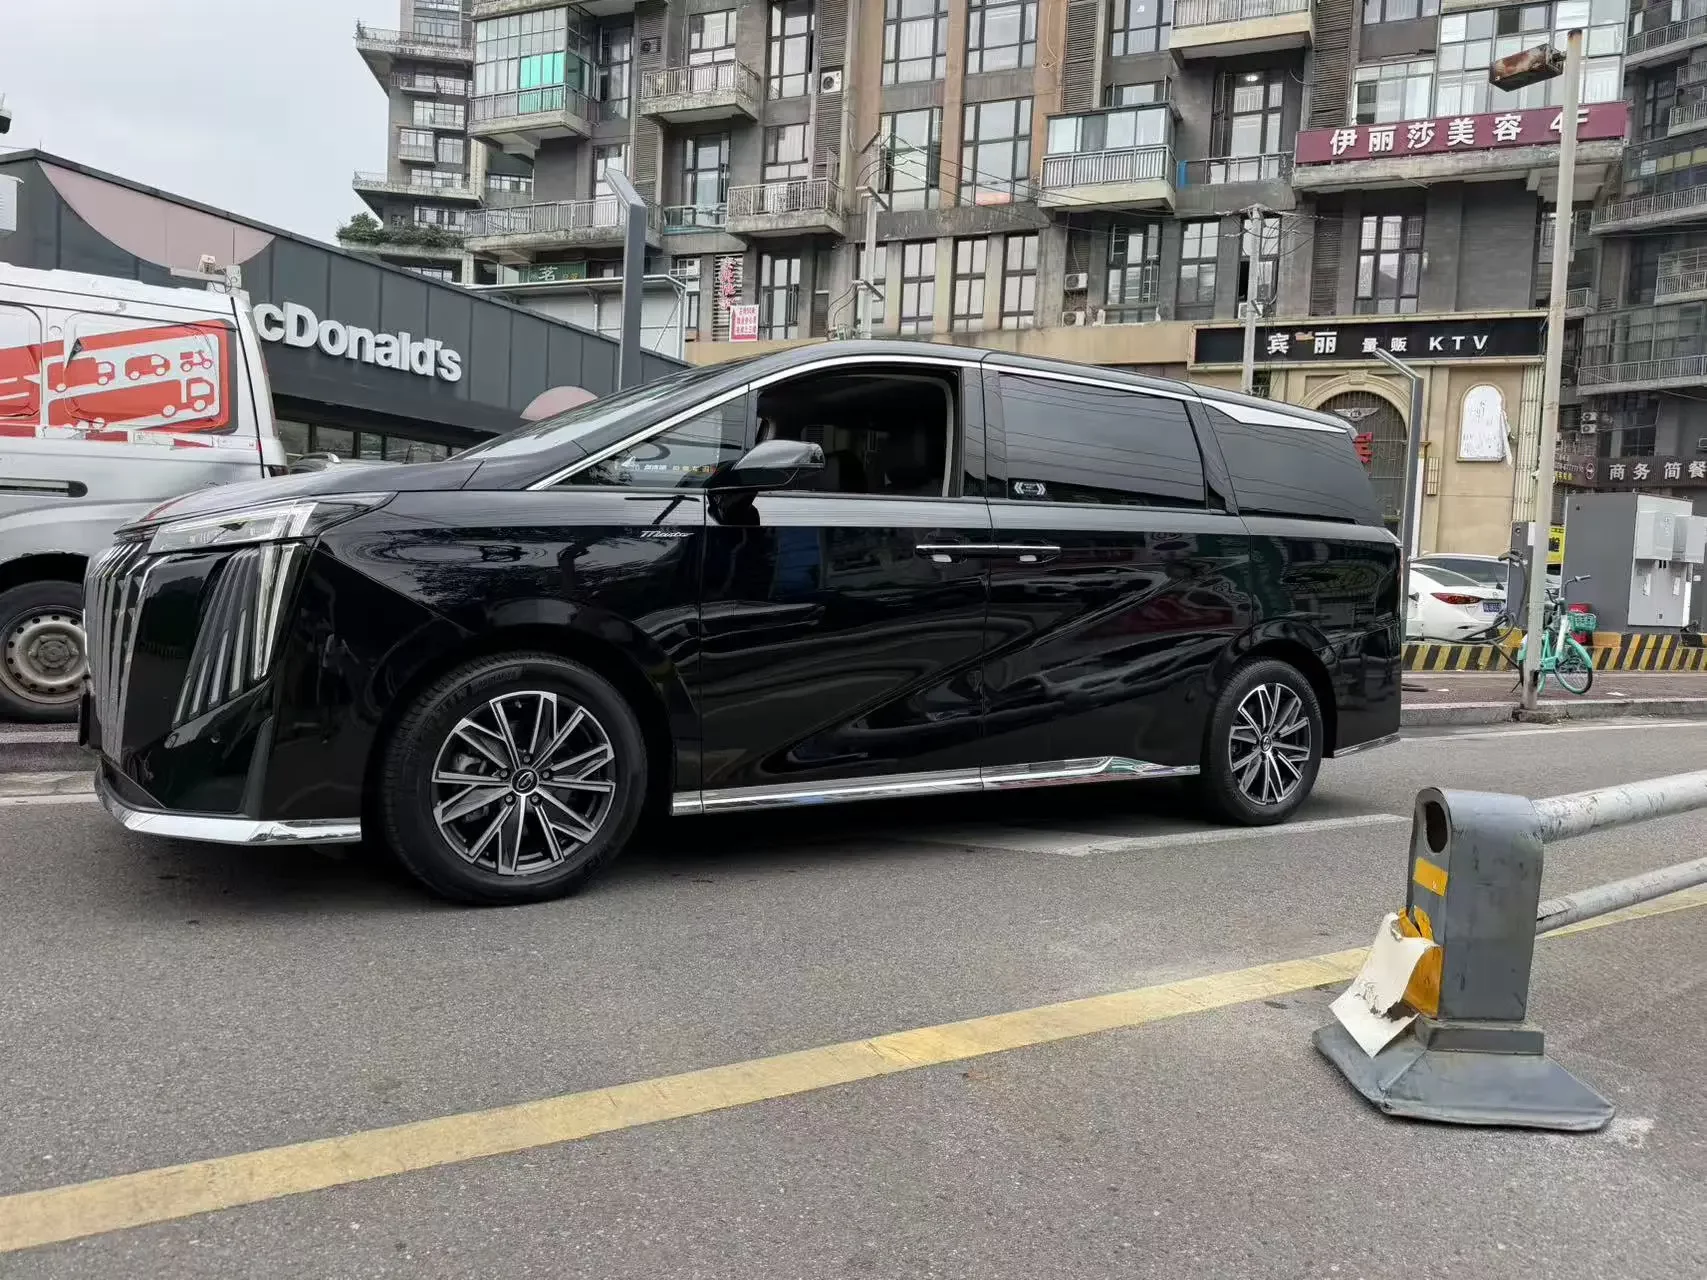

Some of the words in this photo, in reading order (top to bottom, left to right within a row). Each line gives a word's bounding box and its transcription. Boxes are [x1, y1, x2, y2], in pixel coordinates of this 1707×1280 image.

[1329, 113, 1523, 155] 伊丽莎美容
[252, 301, 462, 382] cDonald's
[1429, 335, 1488, 351] KTV
